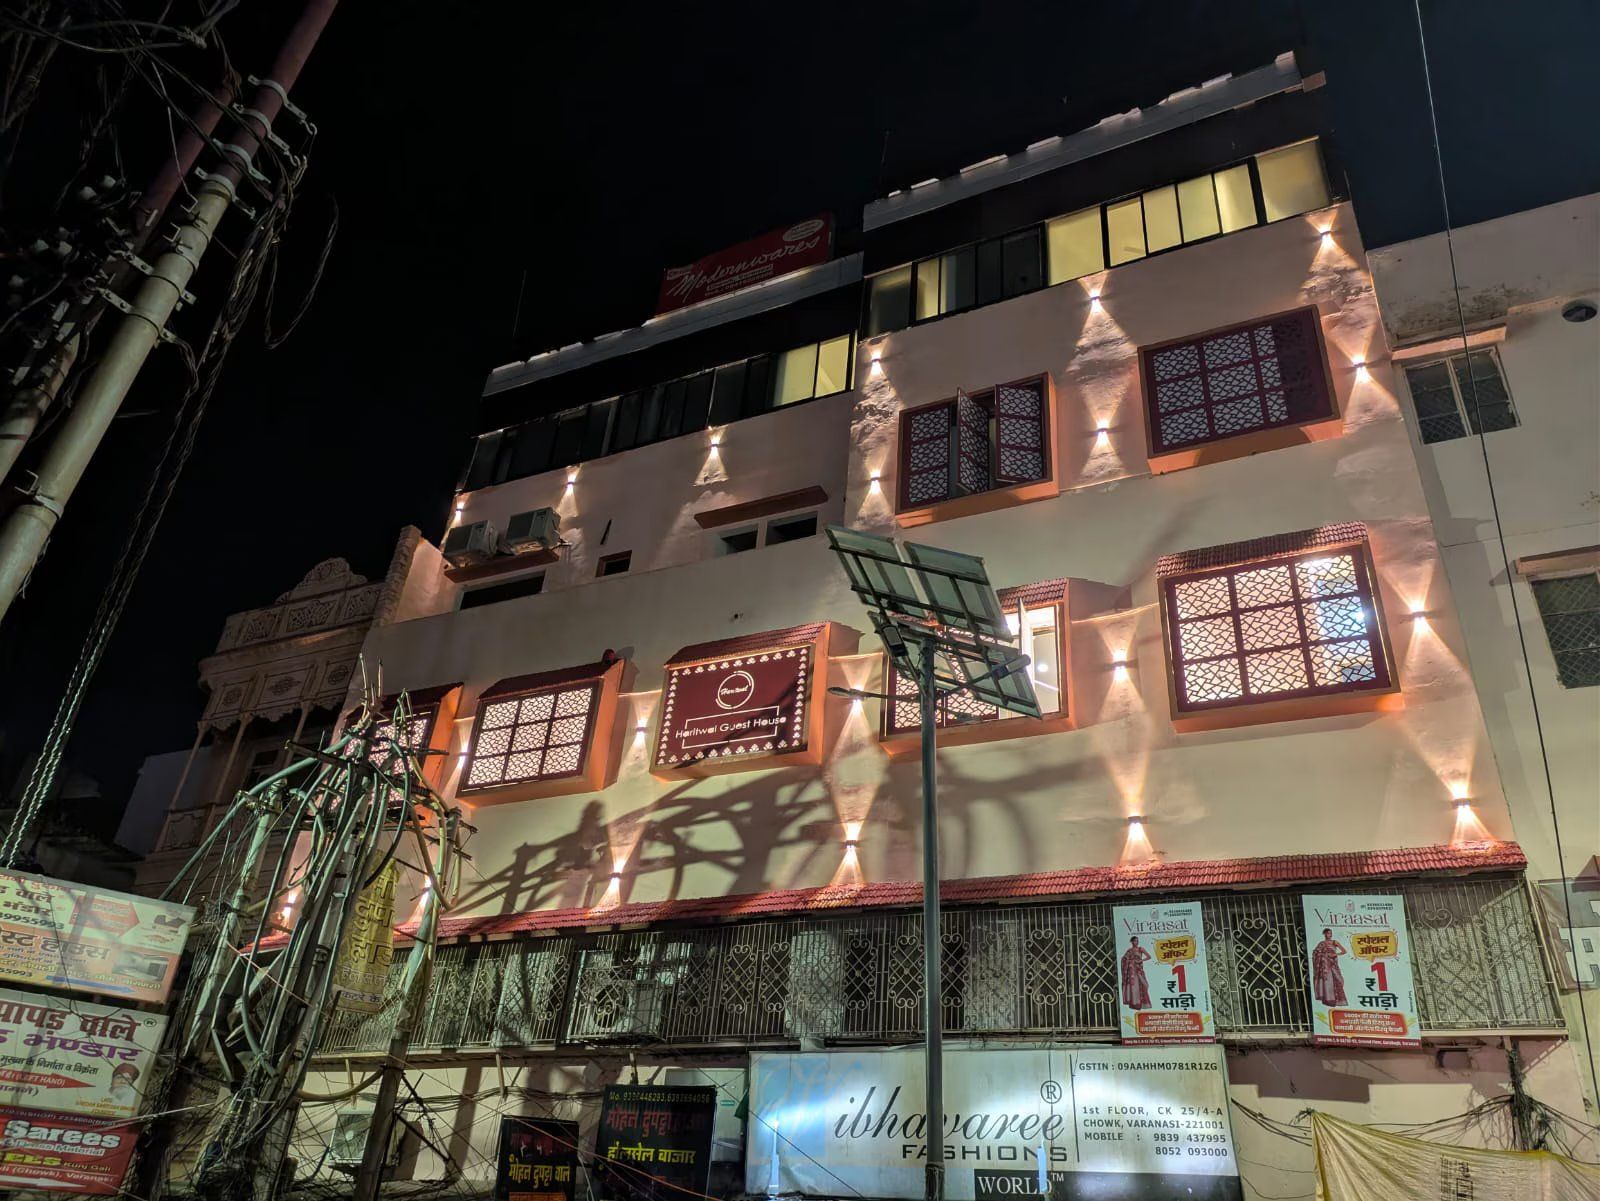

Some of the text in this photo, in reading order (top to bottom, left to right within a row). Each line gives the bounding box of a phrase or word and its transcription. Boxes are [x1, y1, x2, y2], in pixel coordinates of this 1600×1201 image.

[675, 715, 787, 739] Haritwal Guest House
[1314, 907, 1389, 925] Viraasat
[1123, 917, 1189, 933] Viraasat
[1160, 939, 1189, 950] स्पेशल
[1357, 934, 1389, 945] स्पेशल
[1162, 949, 1188, 959] ऑफर
[1359, 945, 1388, 955] ऑफर
[1160, 994, 1197, 1011] साड़ी
[1357, 993, 1399, 1011] साड़ी
[80, 1012, 141, 1041] वाले
[1079, 1062, 1109, 1071] GSTIN
[1117, 1062, 1218, 1071] 09AAHHM0781R1ZG
[1082, 1106, 1224, 1117] 1st FLOOR, CK 25/4-A
[1083, 1119, 1225, 1130] CHOWK, VARANASI-221001
[4, 1119, 121, 1149] Sarees
[1084, 1132, 1124, 1141] MOBILE
[1153, 1133, 1180, 1142] 9839
[1186, 1133, 1226, 1143] 437995
[1155, 1146, 1228, 1157] 8052 093000
